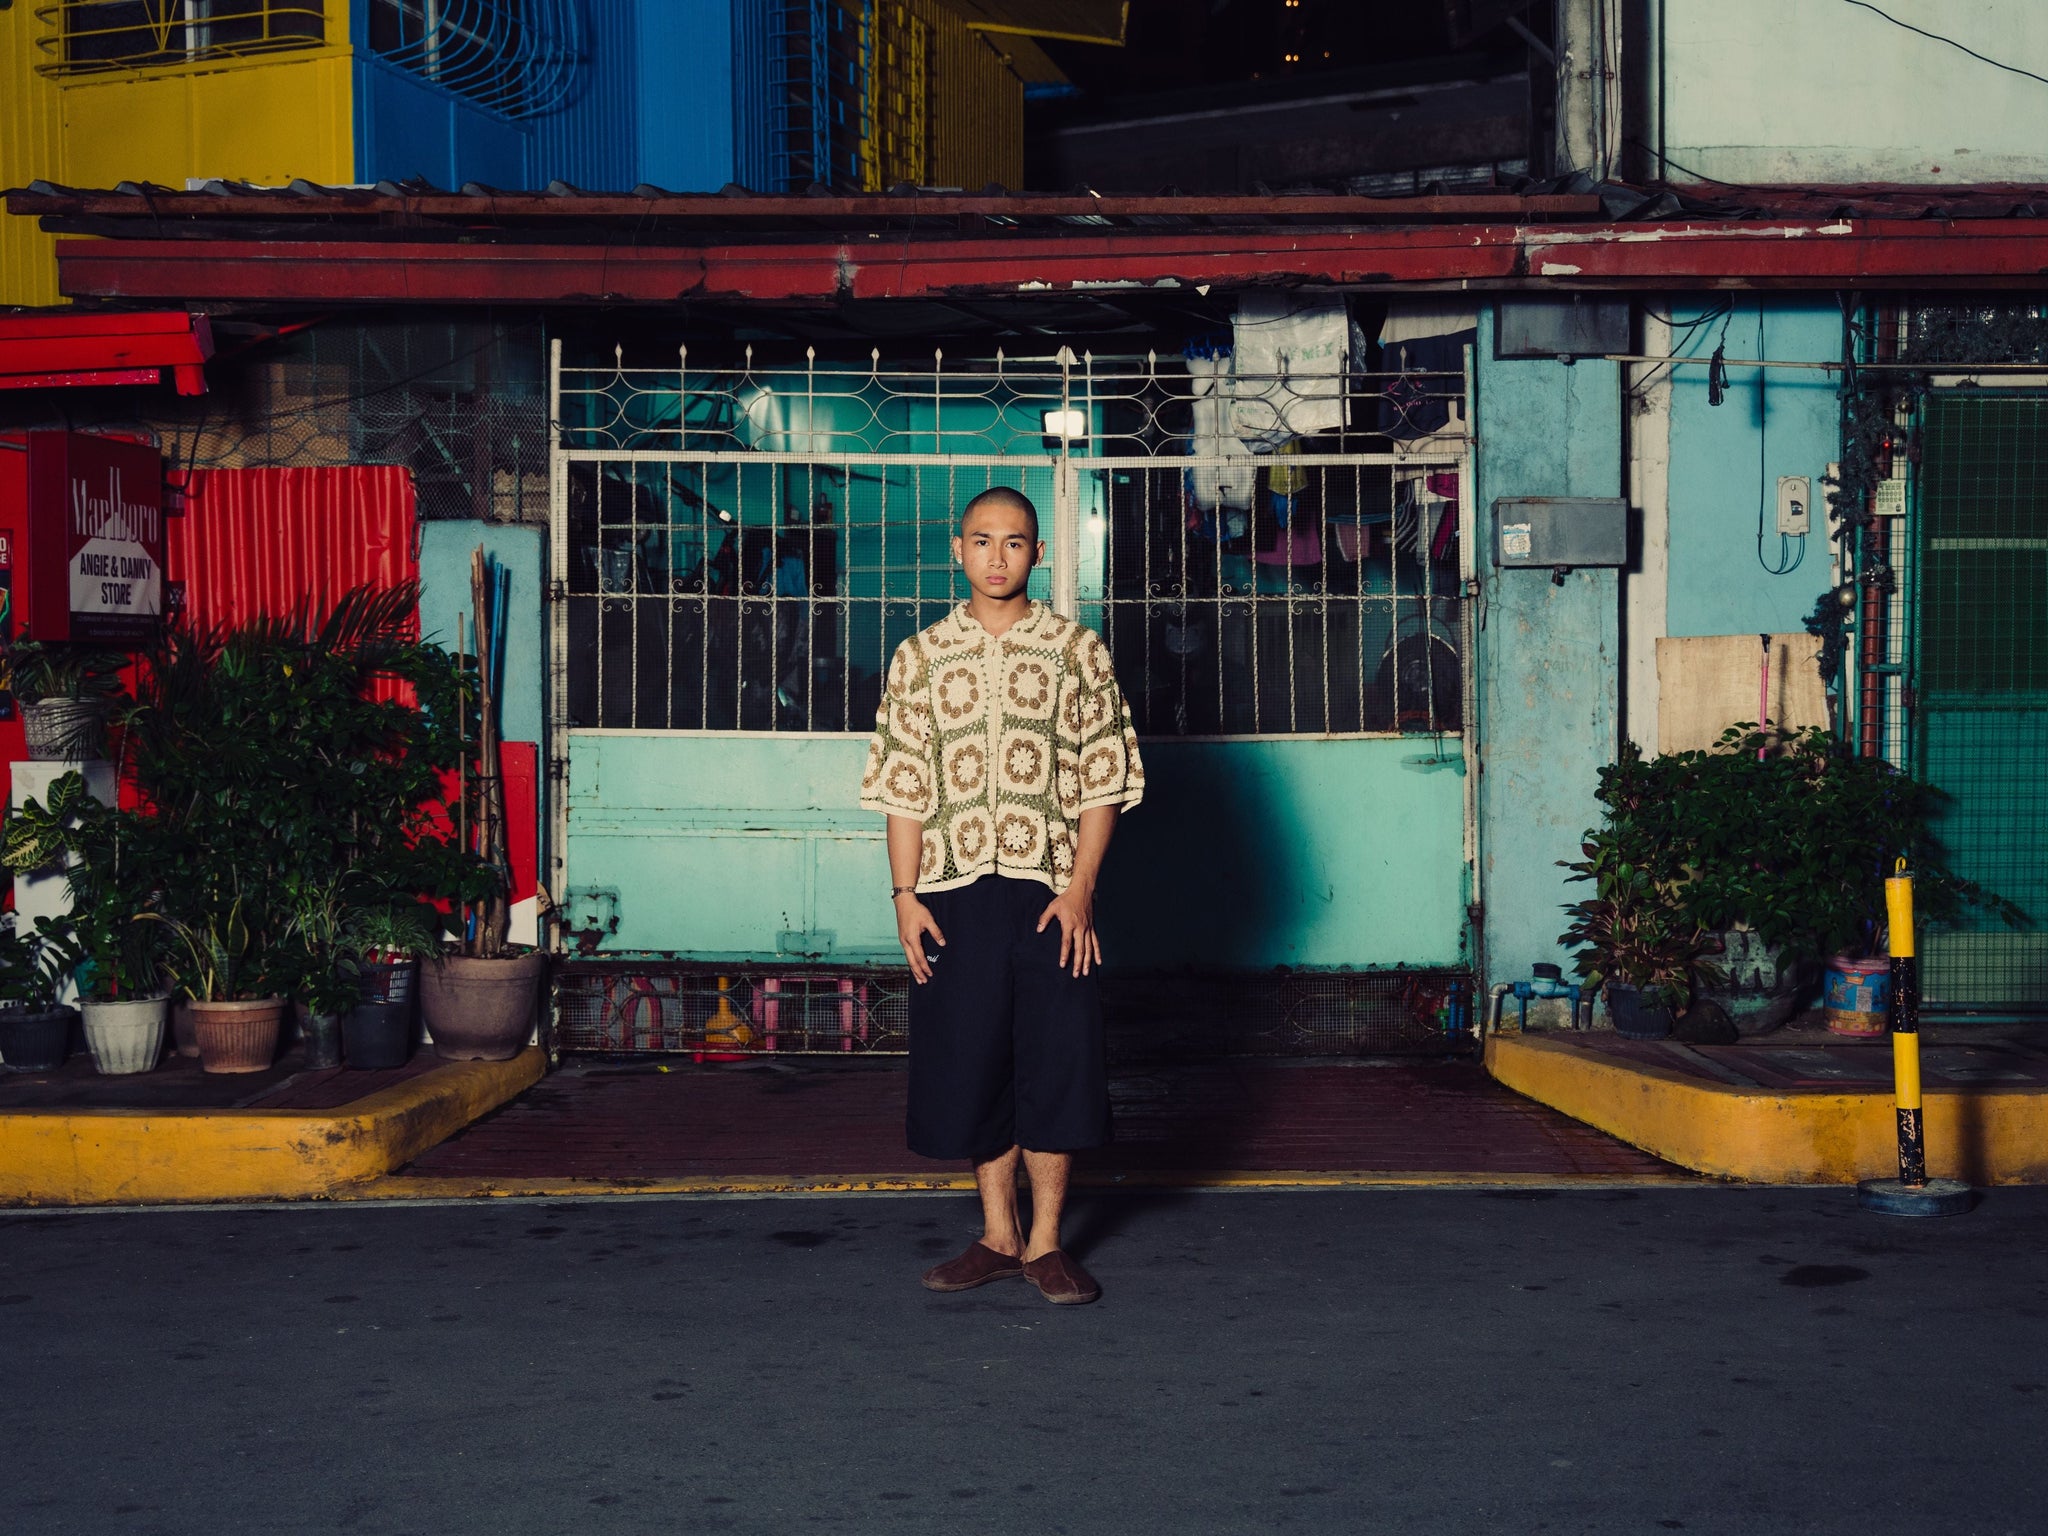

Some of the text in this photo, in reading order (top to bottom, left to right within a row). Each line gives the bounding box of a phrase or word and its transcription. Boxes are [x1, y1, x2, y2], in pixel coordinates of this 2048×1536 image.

[73, 466, 157, 543] Marlboro
[80, 553, 151, 579] ANGIE & DANNY
[101, 582, 131, 605] STORE
